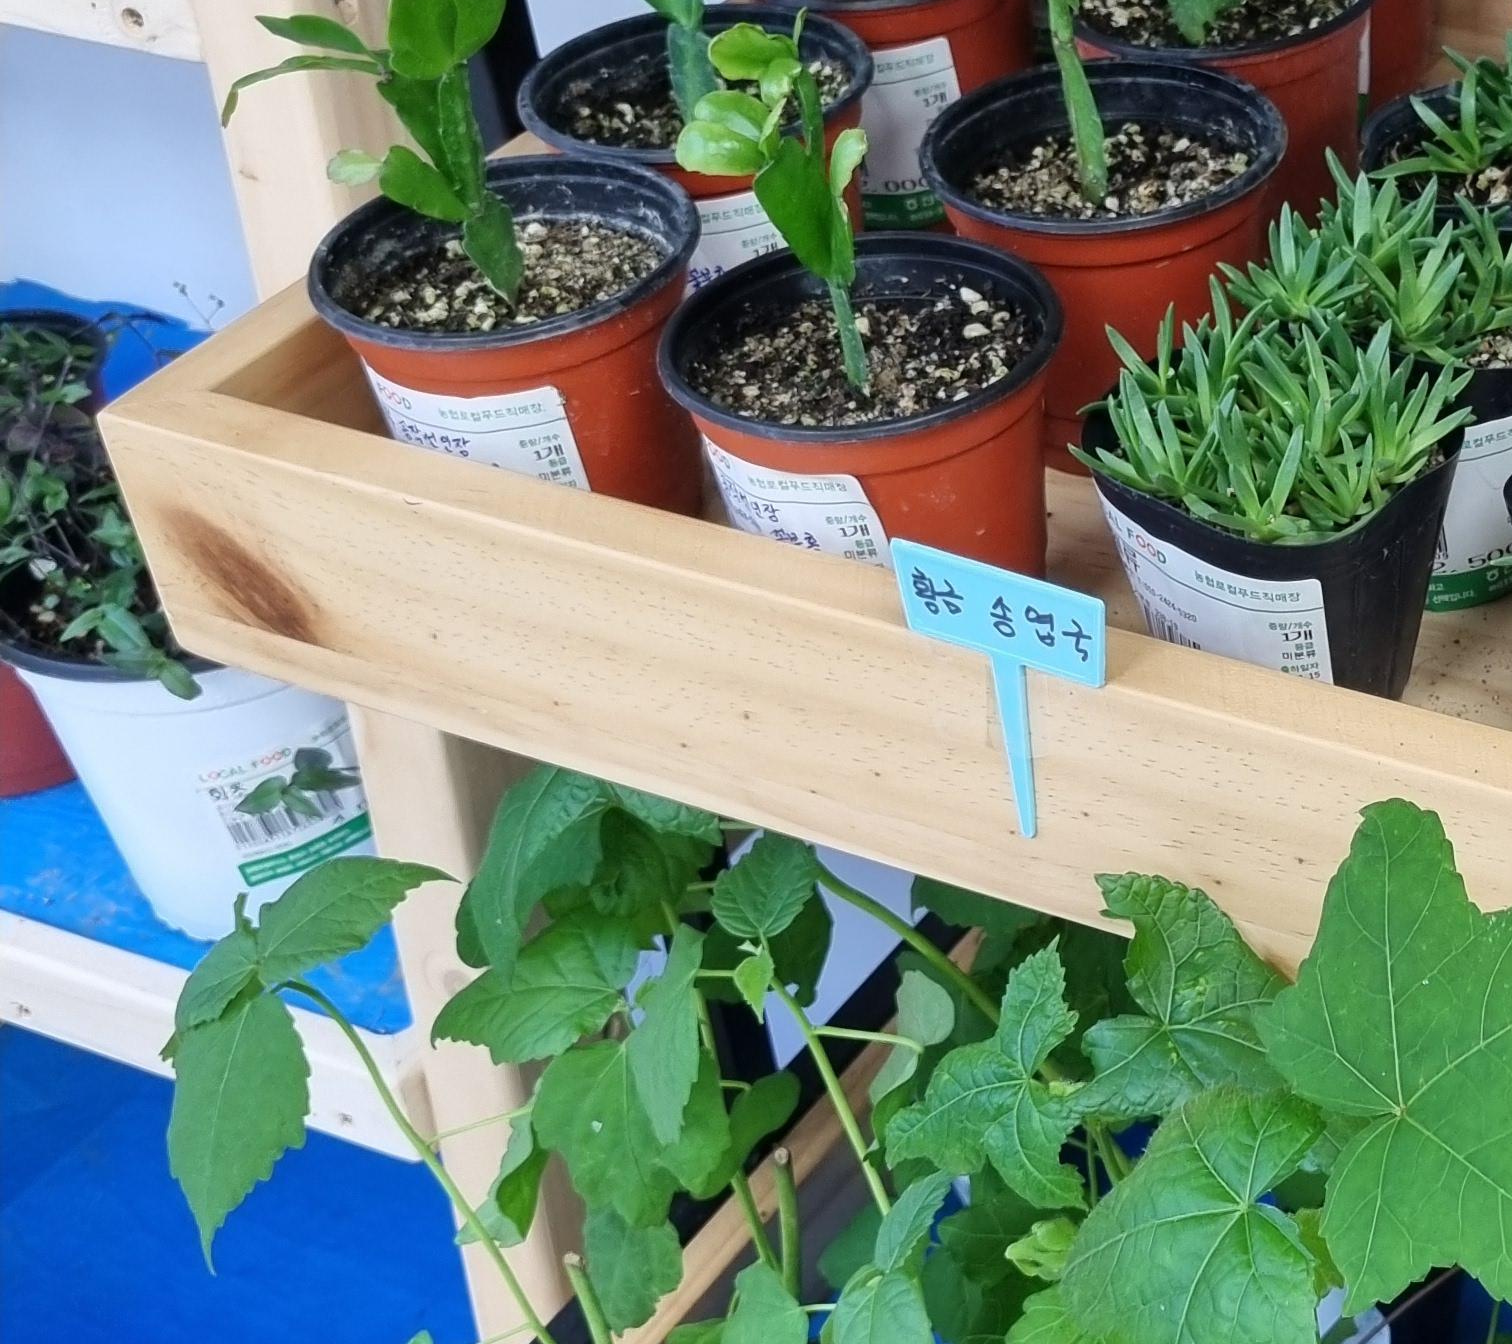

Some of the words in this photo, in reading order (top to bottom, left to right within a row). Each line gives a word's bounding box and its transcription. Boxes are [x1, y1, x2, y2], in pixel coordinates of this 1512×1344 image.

[534, 443, 565, 461] 1개
[839, 522, 871, 538] 1개
[1127, 528, 1167, 565] FOOD
[1281, 629, 1313, 642] 1개
